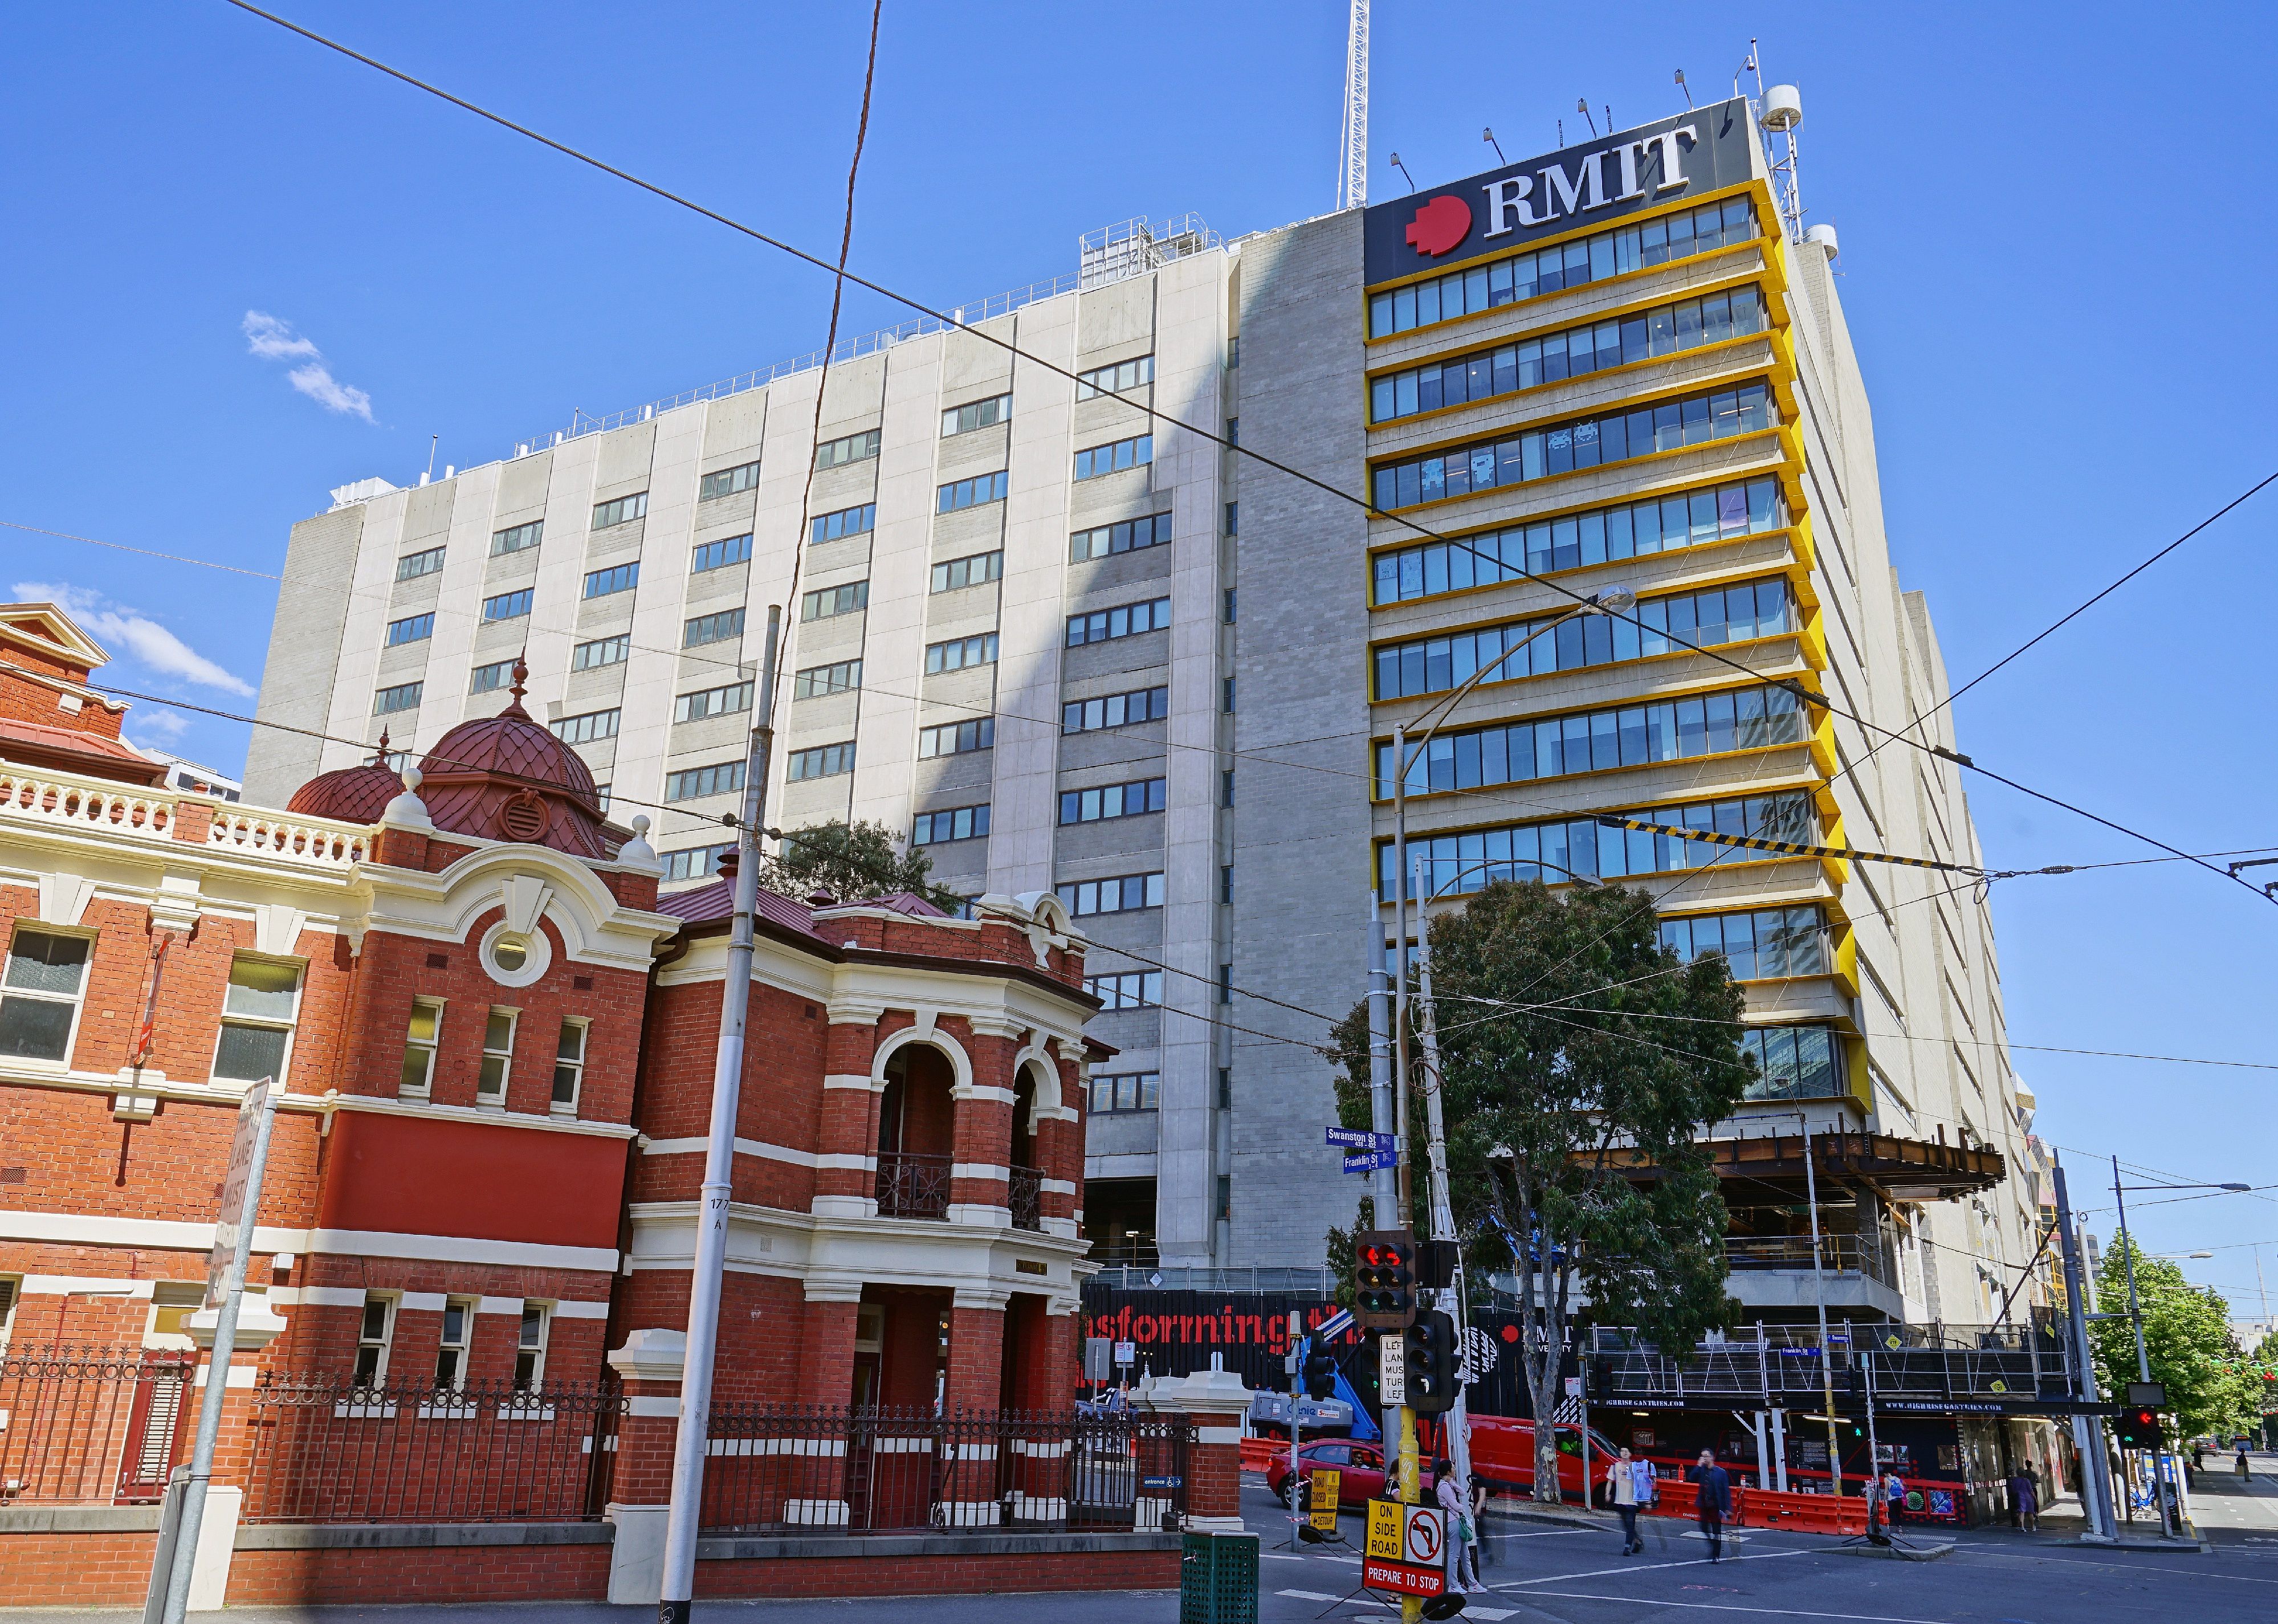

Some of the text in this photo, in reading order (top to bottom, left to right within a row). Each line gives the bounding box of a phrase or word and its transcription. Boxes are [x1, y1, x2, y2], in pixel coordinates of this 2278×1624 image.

[1482, 124, 1697, 239] RMIT
[1328, 1128, 1376, 1143] Swanston St
[230, 1140, 253, 1172] LANE
[1345, 1154, 1378, 1168] Franklin St
[223, 1180, 245, 1210] MUST
[711, 1198, 729, 1210] 177
[714, 1219, 721, 1230] A
[1386, 1341, 1403, 1350] LEF
[1385, 1353, 1403, 1362] LAN
[1386, 1378, 1403, 1386] TUR
[1387, 1390, 1405, 1398] LEF
[1314, 1477, 1325, 1488] ROAD
[1311, 1492, 1326, 1503] CLOSED
[1327, 1496, 1336, 1507] ROAD
[1380, 1504, 1392, 1518] ON
[1317, 1516, 1333, 1525] DETOUR
[1375, 1522, 1396, 1537] SIDE
[1371, 1539, 1398, 1555] ROAD
[1368, 1567, 1439, 1590] PREPARE TO STOP
